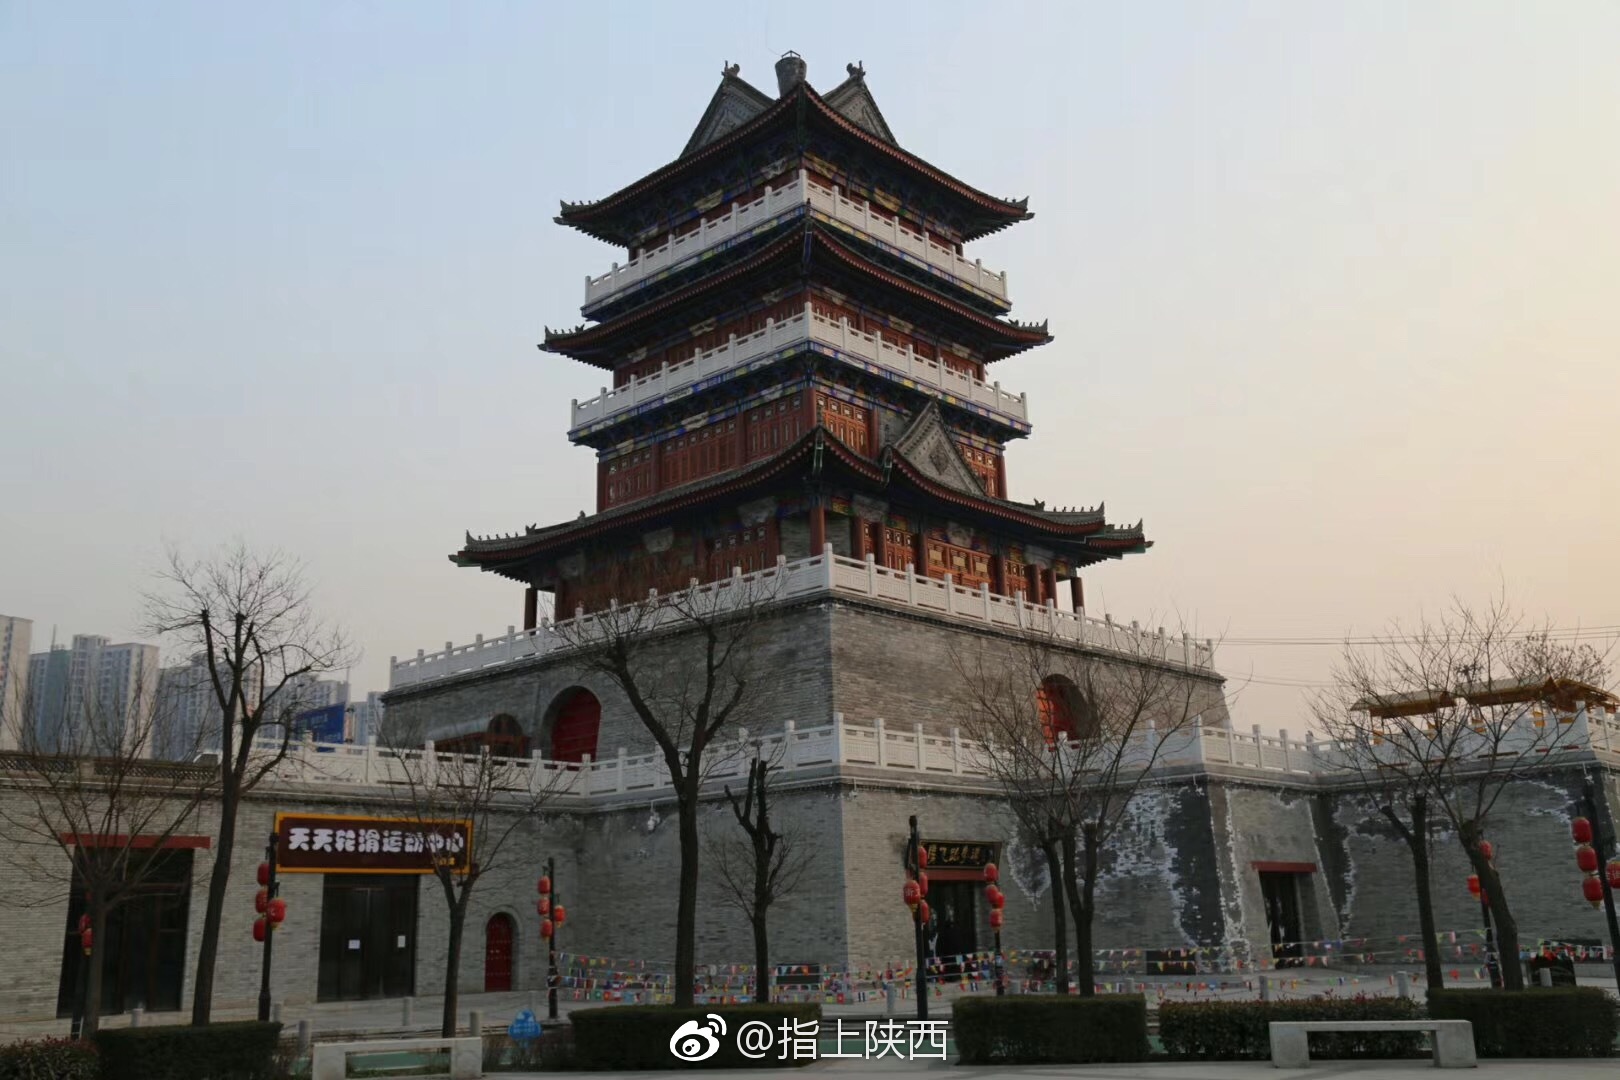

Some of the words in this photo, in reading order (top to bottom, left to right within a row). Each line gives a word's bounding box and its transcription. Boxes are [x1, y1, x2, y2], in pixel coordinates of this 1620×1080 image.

[288, 827, 464, 853] 天天轮滑运动中心
